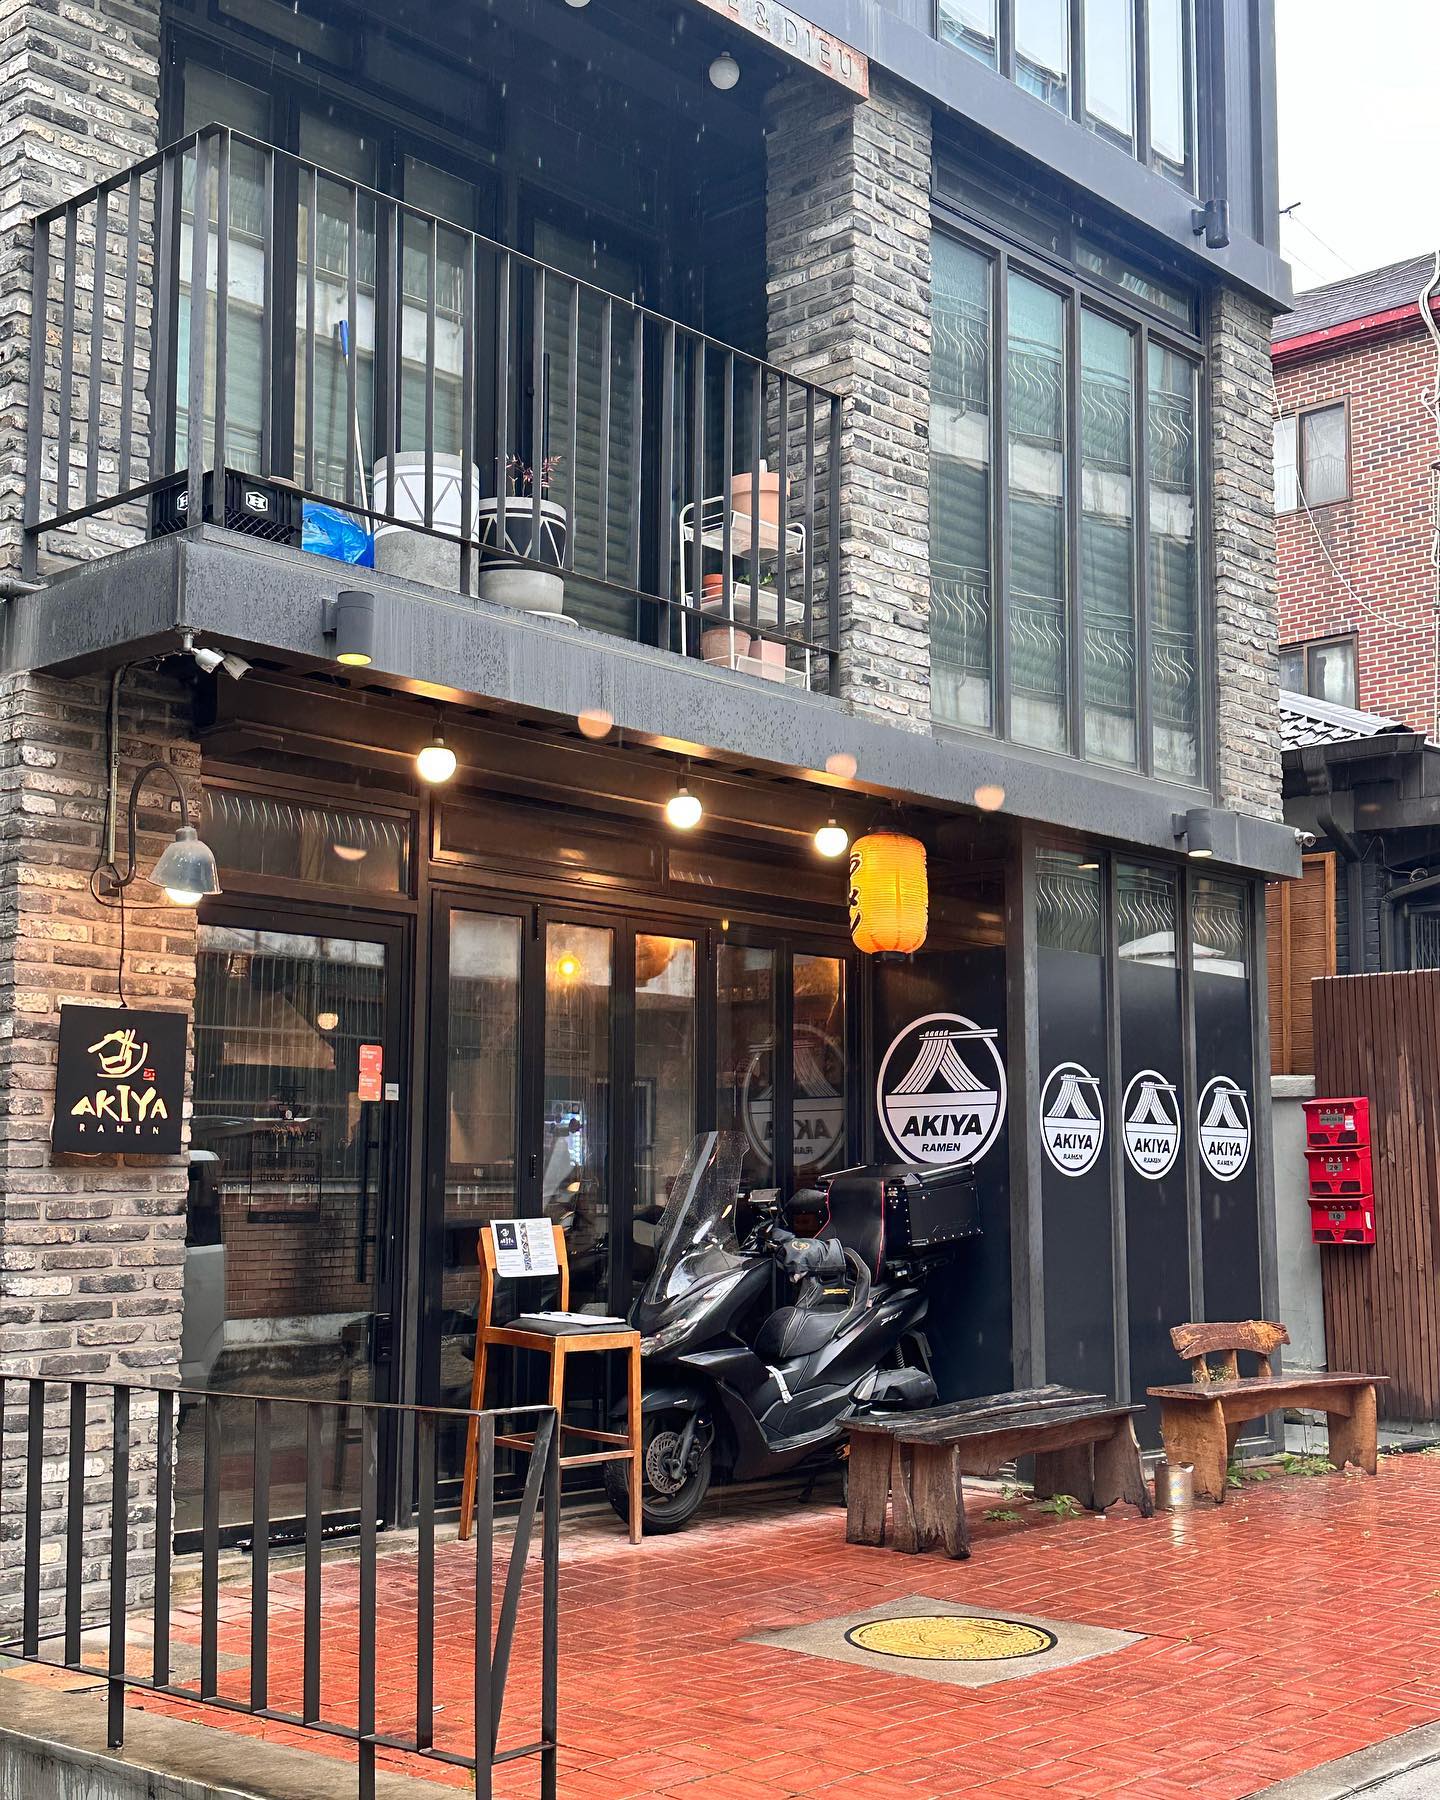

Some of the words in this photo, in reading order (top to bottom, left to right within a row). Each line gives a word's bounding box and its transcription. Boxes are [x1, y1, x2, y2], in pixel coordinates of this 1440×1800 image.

[784, 17, 852, 79] DIEU
[71, 1084, 168, 1122] AKIYA
[79, 1123, 159, 1135] RAMEN
[901, 1113, 983, 1137] AKIYA
[921, 1142, 961, 1152] RAMEN
[1053, 1133, 1093, 1150] AKIYA
[1134, 1138, 1171, 1154] AKIYA
[1208, 1141, 1242, 1157] AKIYA
